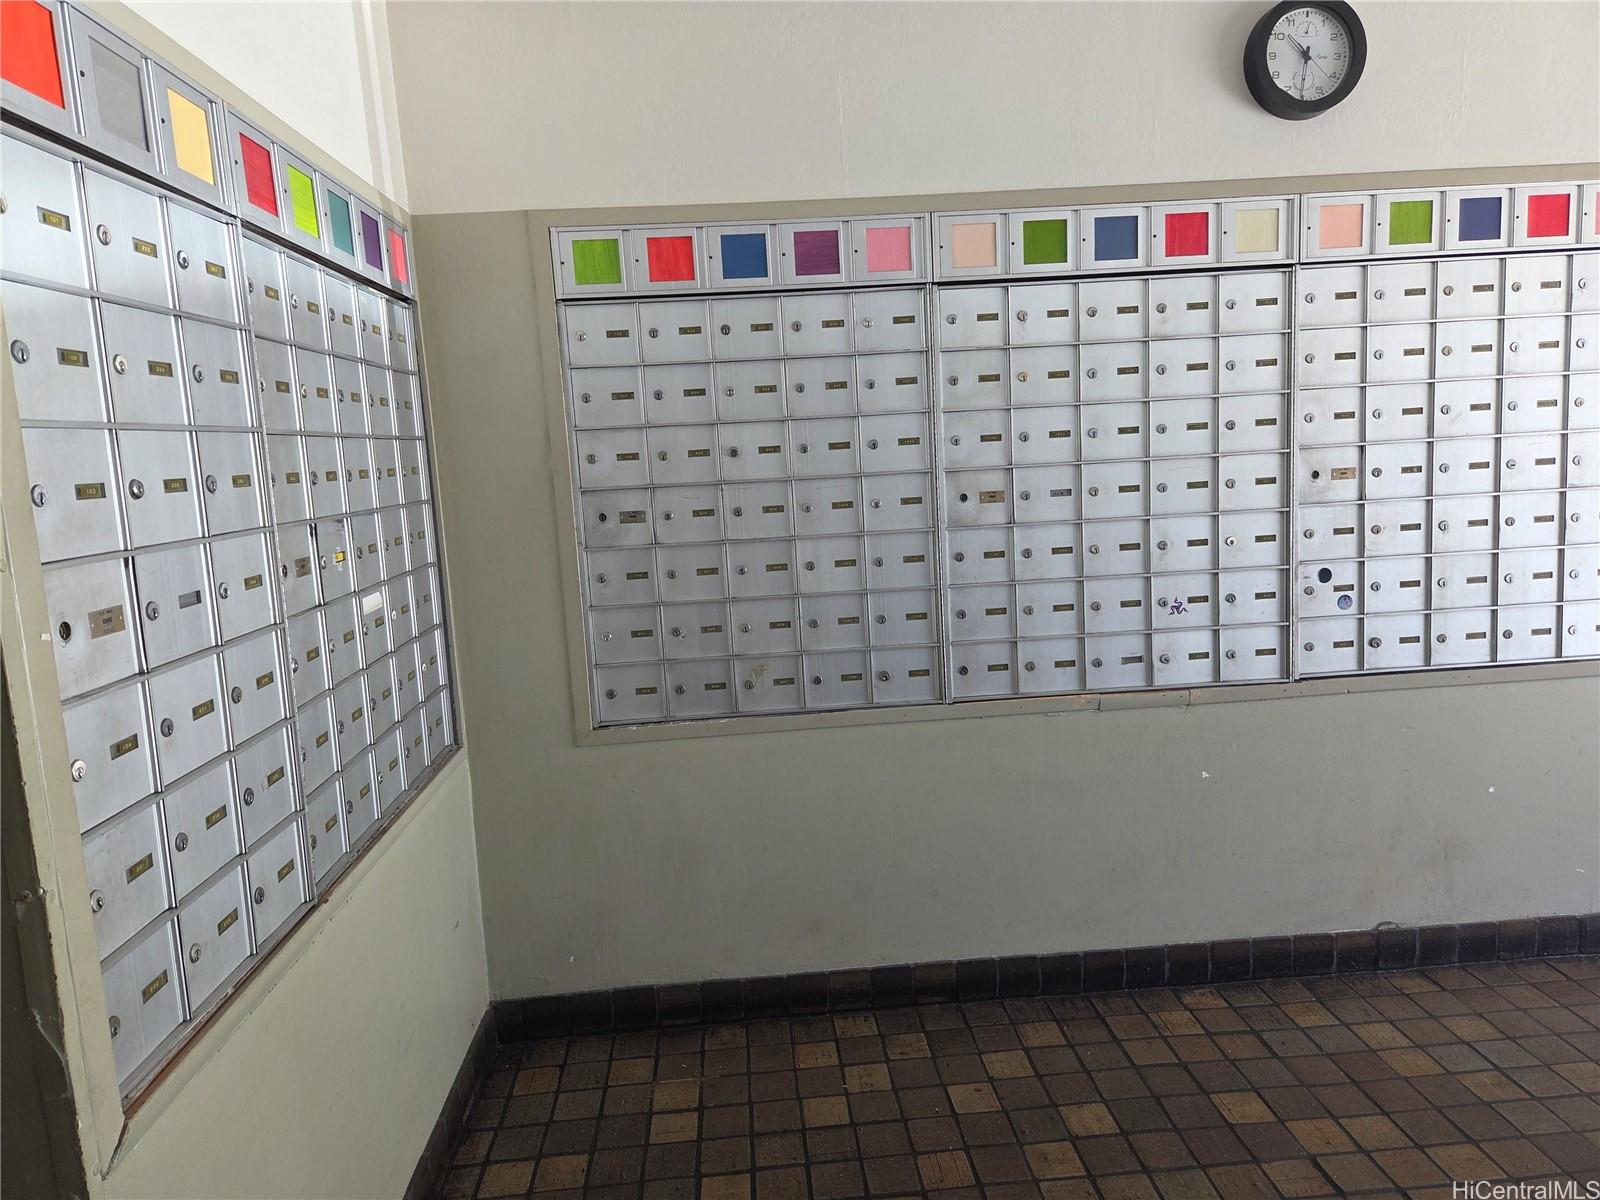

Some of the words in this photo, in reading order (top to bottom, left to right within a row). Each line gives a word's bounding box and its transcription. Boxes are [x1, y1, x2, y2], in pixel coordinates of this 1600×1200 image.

[1286, 19, 1296, 27] 11
[1321, 19, 1326, 28] 1
[1273, 32, 1285, 41] 10
[1330, 33, 1338, 41] 2
[1268, 52, 1276, 60] 9
[1333, 52, 1341, 60] 3
[1272, 71, 1280, 79] 8
[1328, 72, 1336, 80] 4
[1315, 86, 1323, 94] 5
